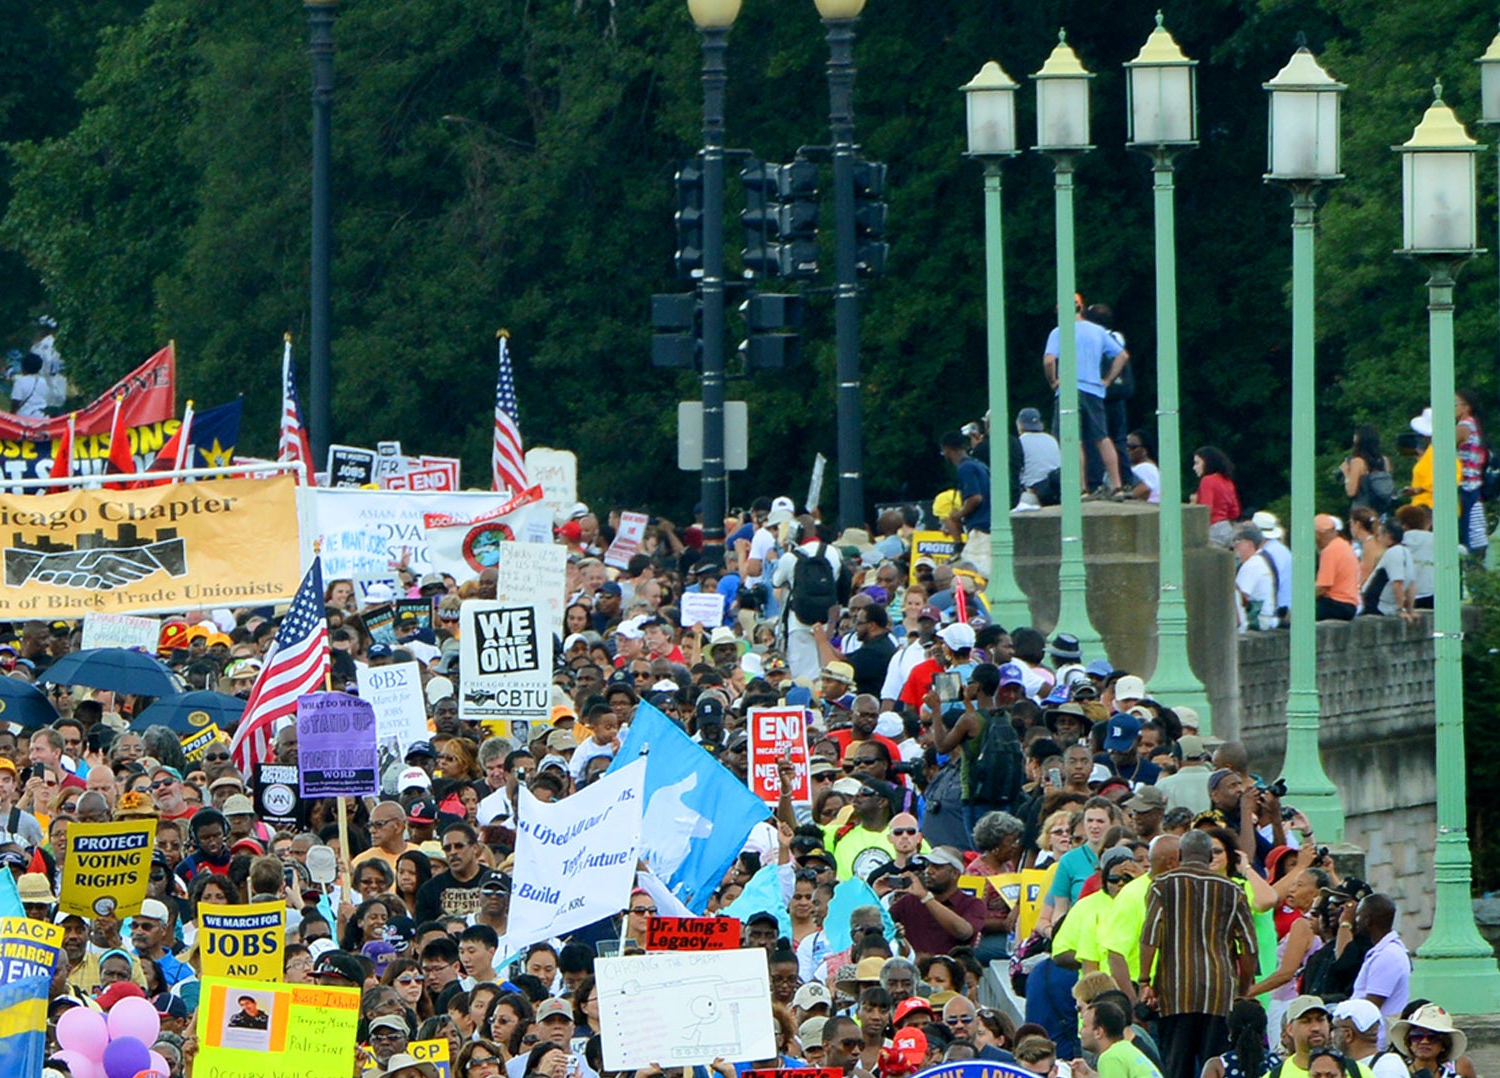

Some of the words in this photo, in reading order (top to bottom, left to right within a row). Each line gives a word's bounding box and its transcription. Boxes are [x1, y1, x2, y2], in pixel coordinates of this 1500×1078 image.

[337, 464, 366, 479] JOBS
[413, 472, 446, 489] END
[99, 494, 238, 526] Chapter
[360, 510, 395, 519] ASIAN
[30, 594, 44, 610] of
[48, 592, 106, 609] Black
[111, 586, 177, 605] Trade
[185, 579, 284, 600] Unionists
[477, 610, 532, 639] WE
[483, 636, 529, 648] ARE
[480, 645, 535, 672] ONE
[496, 689, 548, 708] CBTU
[301, 713, 350, 735] STAND
[353, 713, 373, 731] UP
[759, 716, 800, 741] END
[322, 770, 356, 778] WORD
[266, 794, 291, 808] NAN
[78, 832, 148, 851] PROTECT
[77, 852, 141, 868] VOTING
[75, 871, 138, 888] RIGHTS
[518, 883, 561, 905] Build
[569, 896, 586, 911] KRC
[205, 915, 222, 927] WE
[224, 913, 259, 927] MARCH
[260, 913, 280, 925] FOR
[650, 918, 673, 932] Dr.
[677, 918, 729, 933] King's
[205, 930, 278, 955] JOBS
[650, 932, 723, 949] Legacy...
[226, 963, 259, 976] AND
